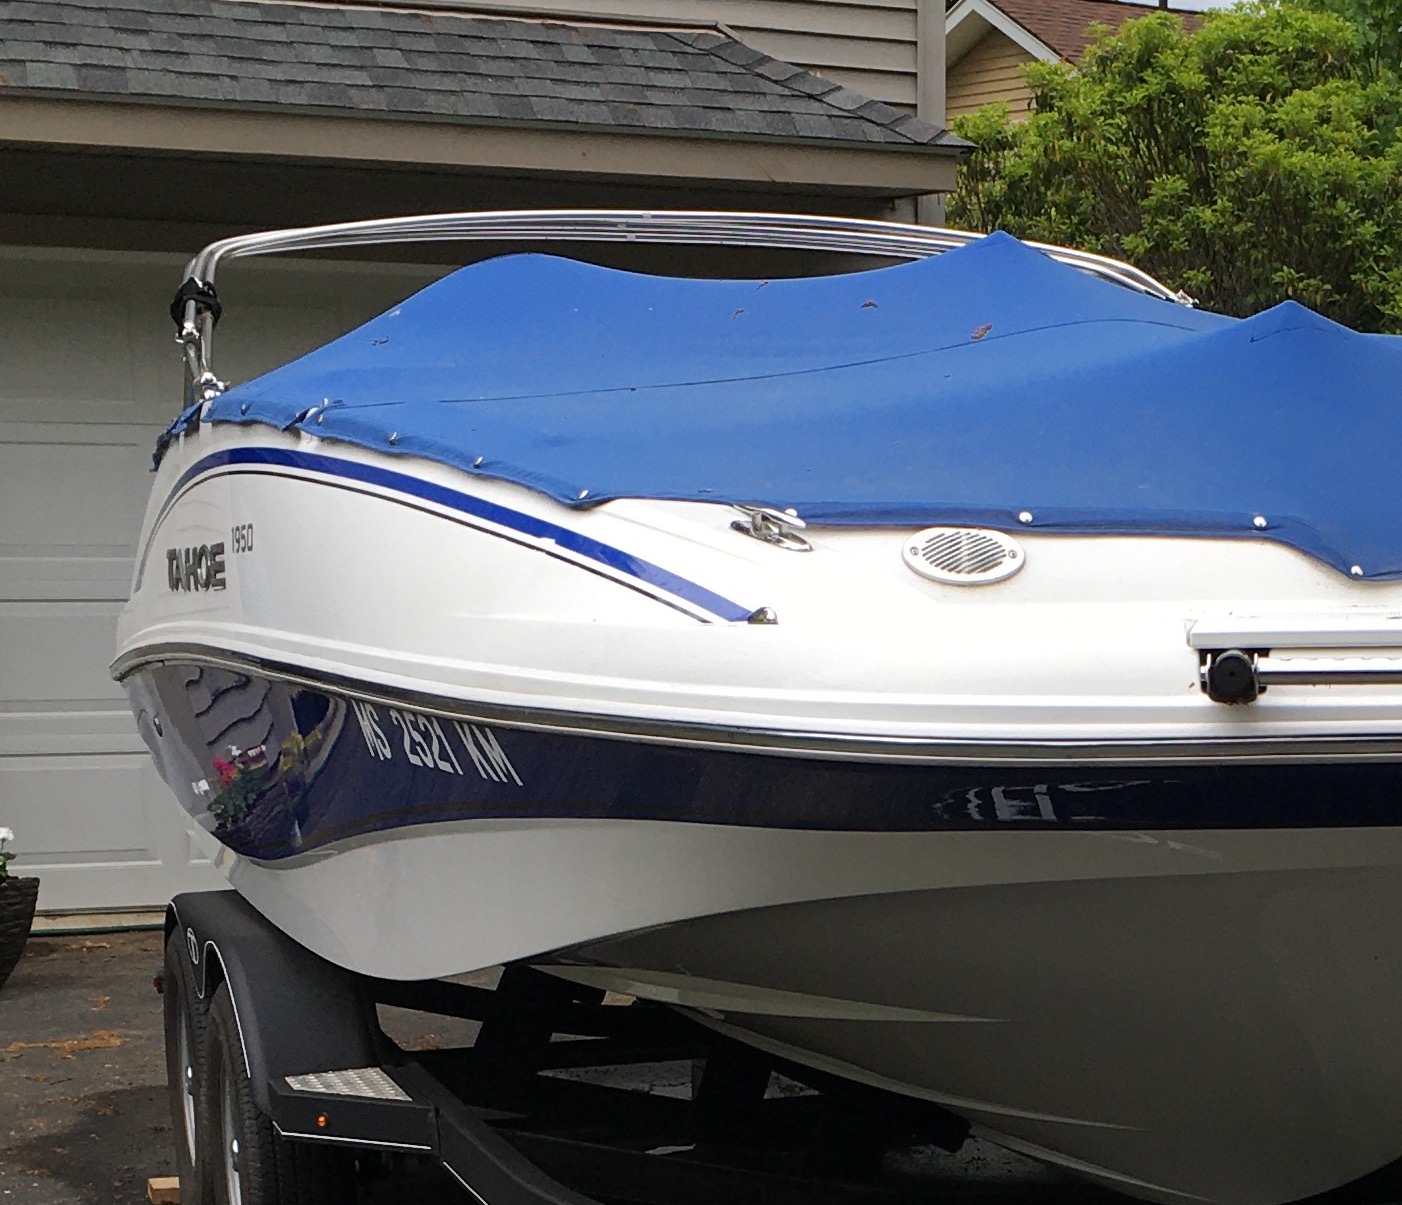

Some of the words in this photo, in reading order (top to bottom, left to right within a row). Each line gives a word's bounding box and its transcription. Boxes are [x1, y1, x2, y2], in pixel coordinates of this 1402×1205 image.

[166, 541, 227, 592] TAHOE
[231, 523, 254, 554] 1950
[351, 699, 392, 760] MS
[453, 721, 523, 786] KM
